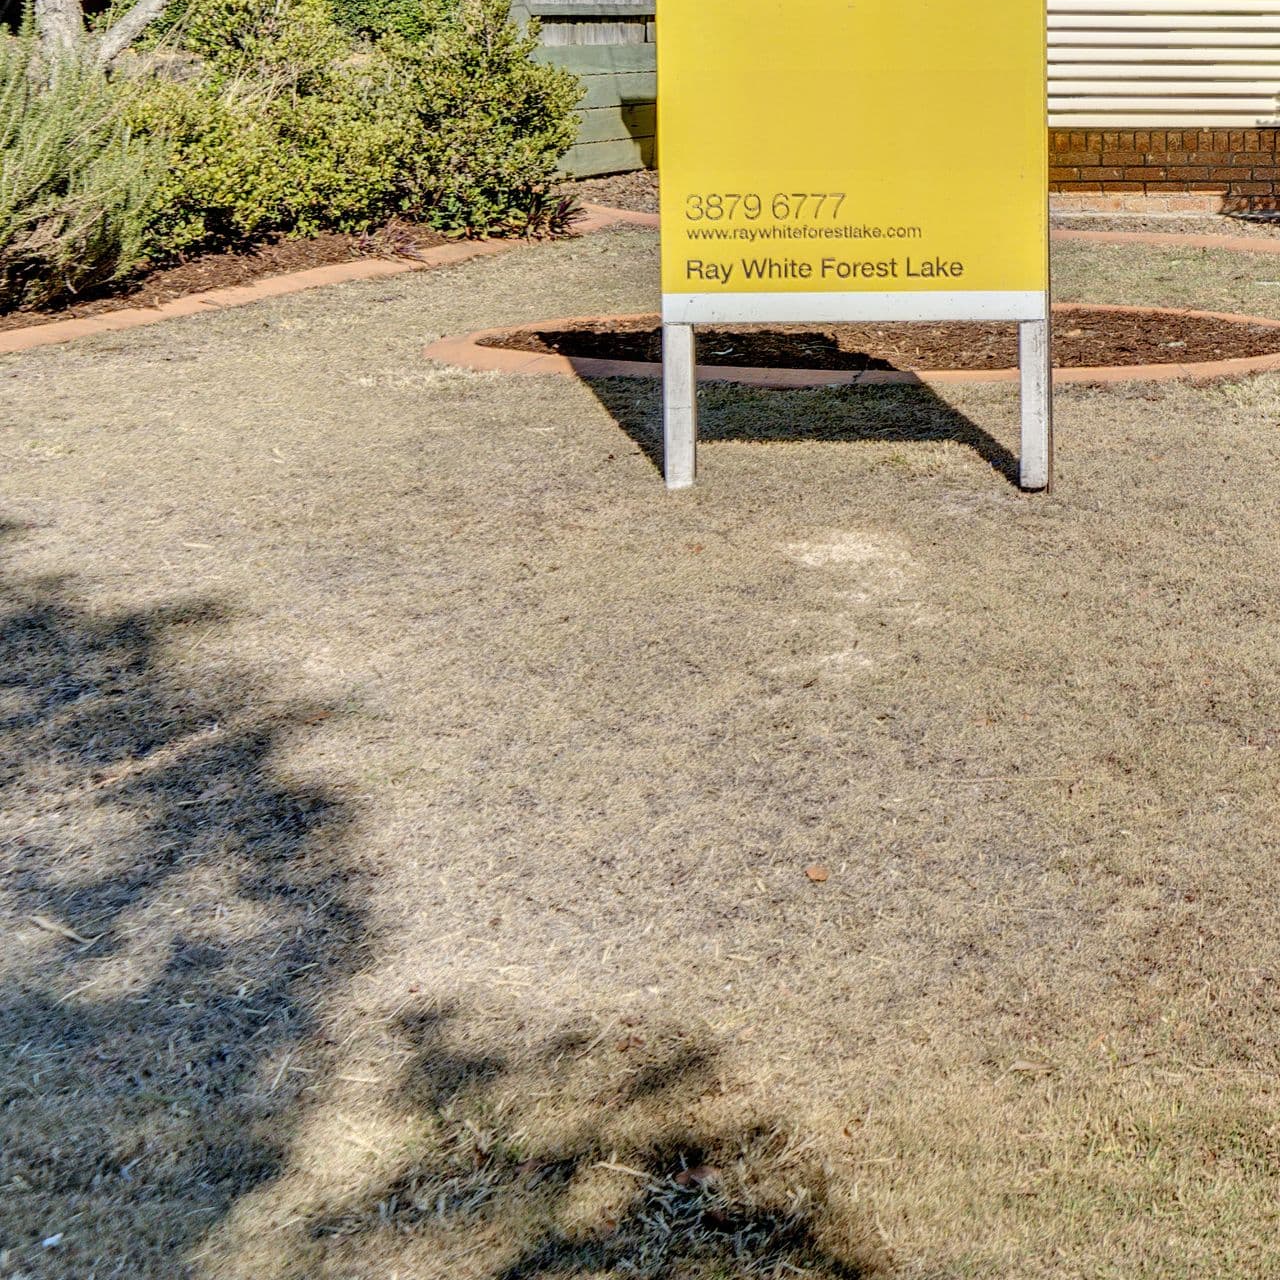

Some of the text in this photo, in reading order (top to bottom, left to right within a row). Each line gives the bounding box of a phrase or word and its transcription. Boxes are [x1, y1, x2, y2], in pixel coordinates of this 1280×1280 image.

[686, 192, 846, 222] 3879 6777
[687, 224, 922, 244] www.raywhiteforestlake.com
[687, 257, 964, 285] Ray White Forest Lake
